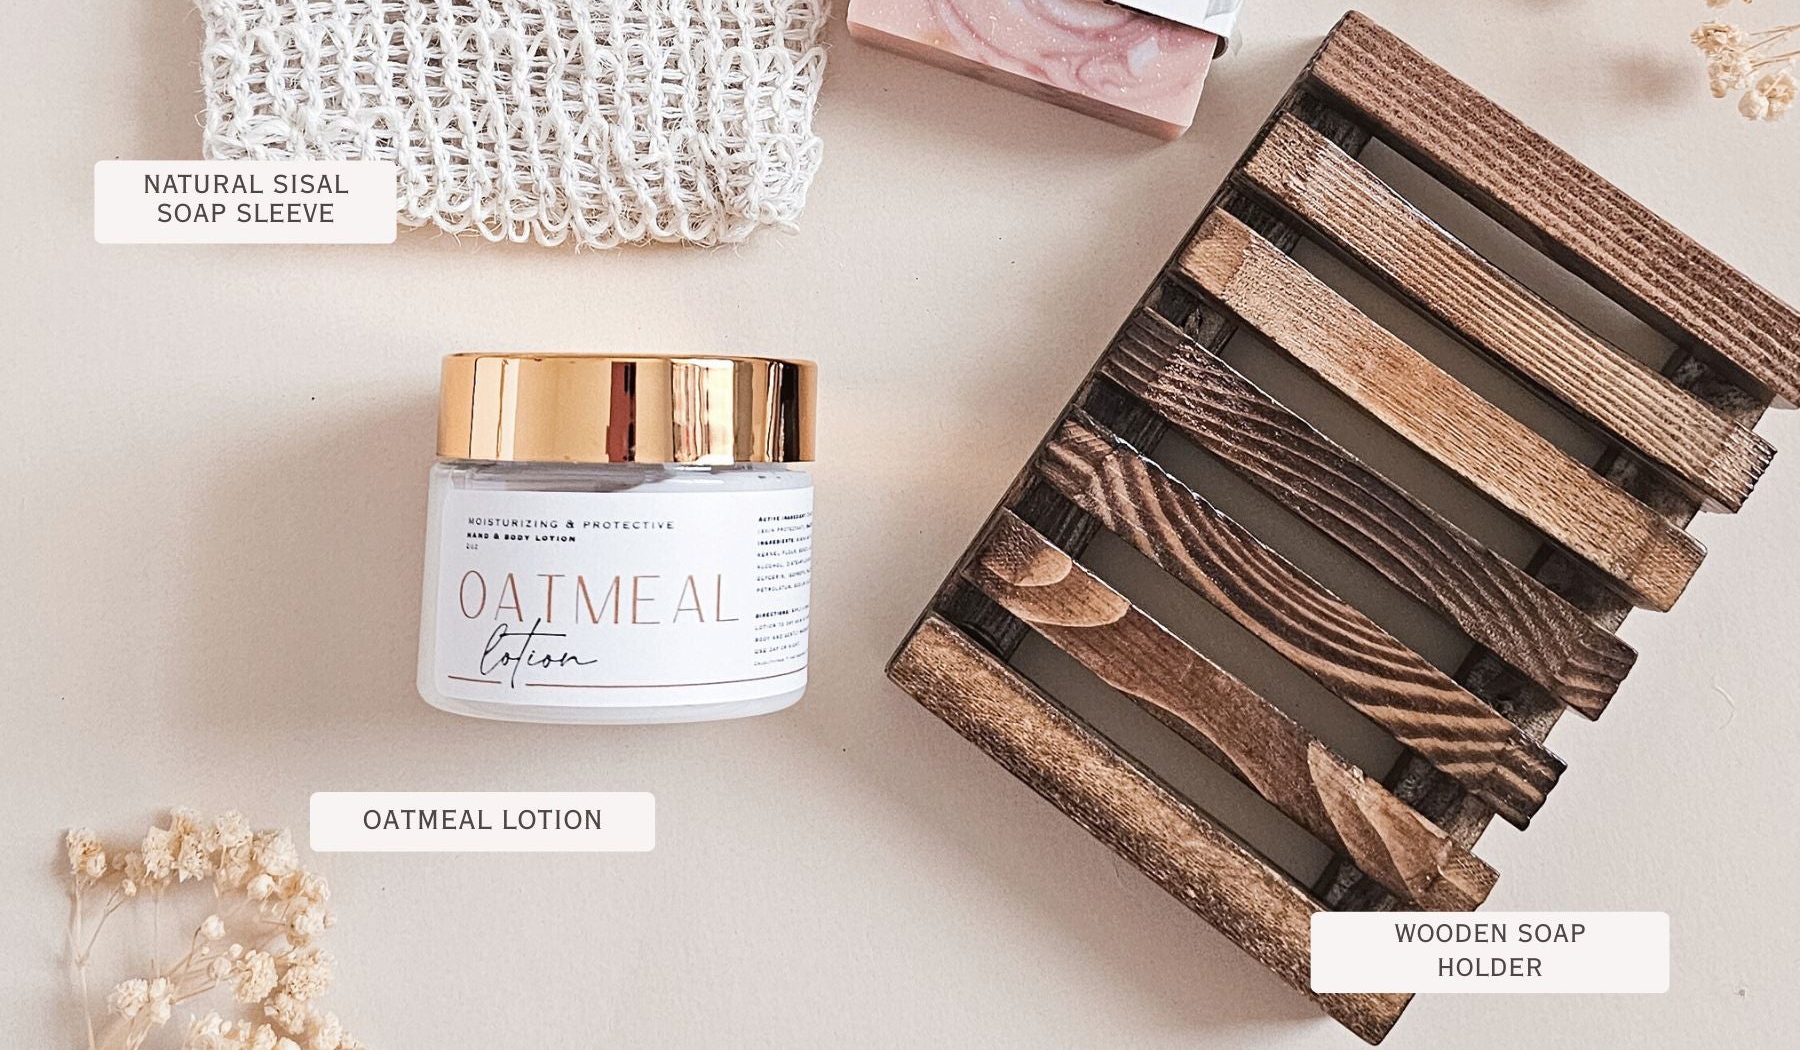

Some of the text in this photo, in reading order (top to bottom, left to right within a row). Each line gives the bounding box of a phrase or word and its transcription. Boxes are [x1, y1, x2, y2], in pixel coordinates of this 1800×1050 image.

[468, 516, 675, 530] MOISTURIZING & PROTECTIVE
[459, 570, 740, 626] OATMEAL
[480, 617, 598, 689] lotion
